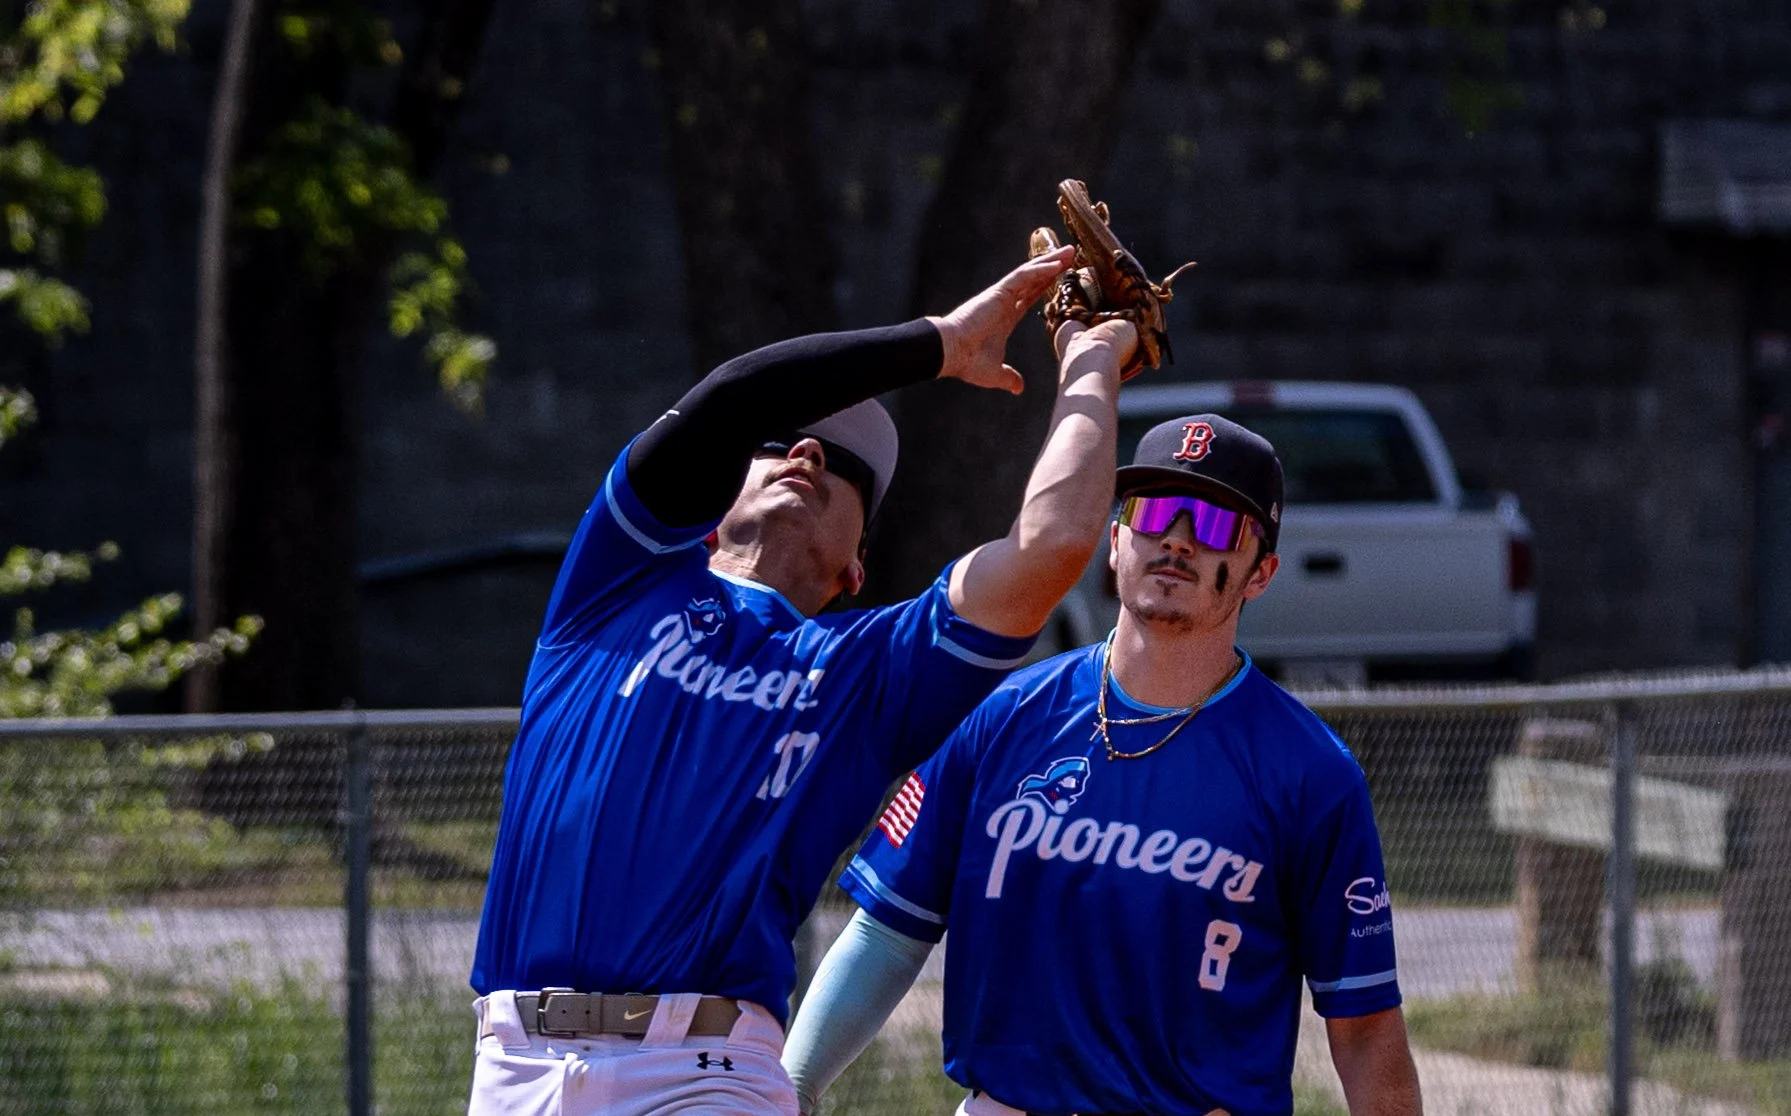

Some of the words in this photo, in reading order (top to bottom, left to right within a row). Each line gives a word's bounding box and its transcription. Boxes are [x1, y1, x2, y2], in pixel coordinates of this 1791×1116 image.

[1172, 421, 1217, 462] B
[985, 799, 1265, 904] Pioneers
[1198, 919, 1243, 992] 8
